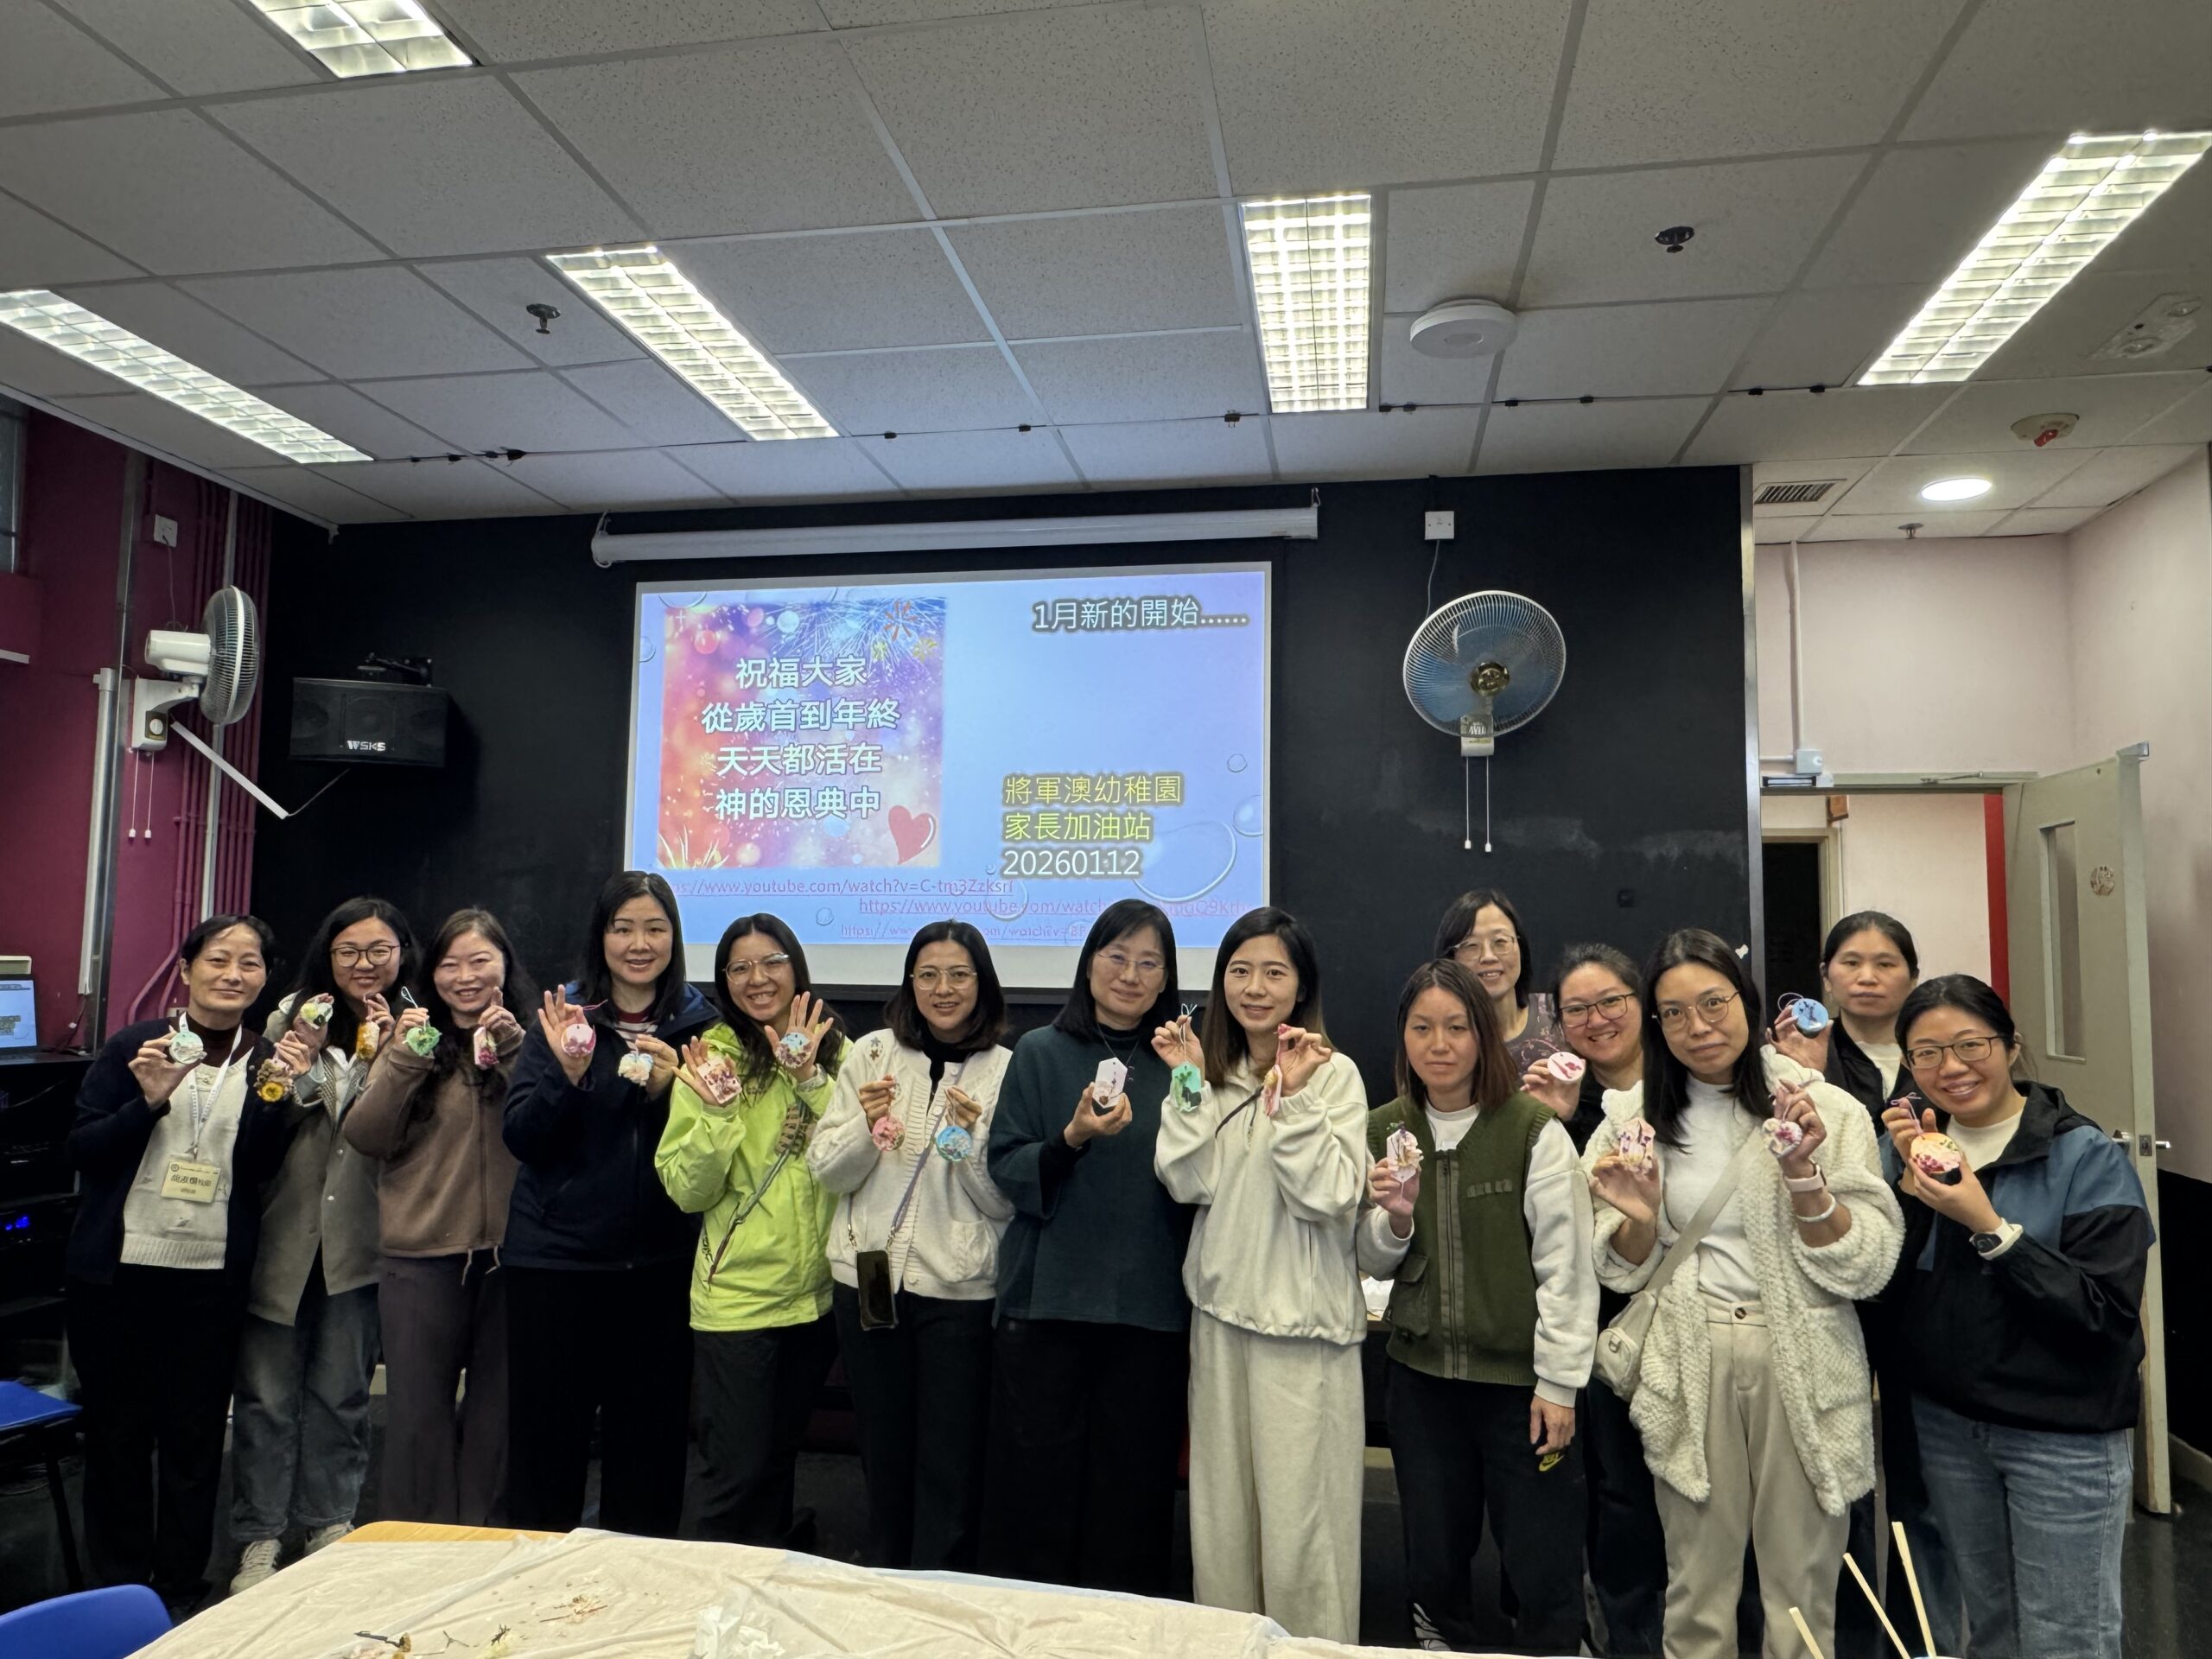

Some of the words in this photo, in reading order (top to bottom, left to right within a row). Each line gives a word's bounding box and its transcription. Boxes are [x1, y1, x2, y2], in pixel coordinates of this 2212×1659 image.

[735, 656, 868, 689] 祝福大家
[701, 697, 900, 734] 從歲首到年終
[346, 740, 386, 752] WSKS
[716, 741, 883, 777] 天天都活在
[715, 785, 880, 821] 神的恩典中
[1004, 775, 1181, 804] 將軍澳幼稚園
[1004, 812, 1151, 841] 家長加油站
[1002, 849, 1141, 876] 20260112
